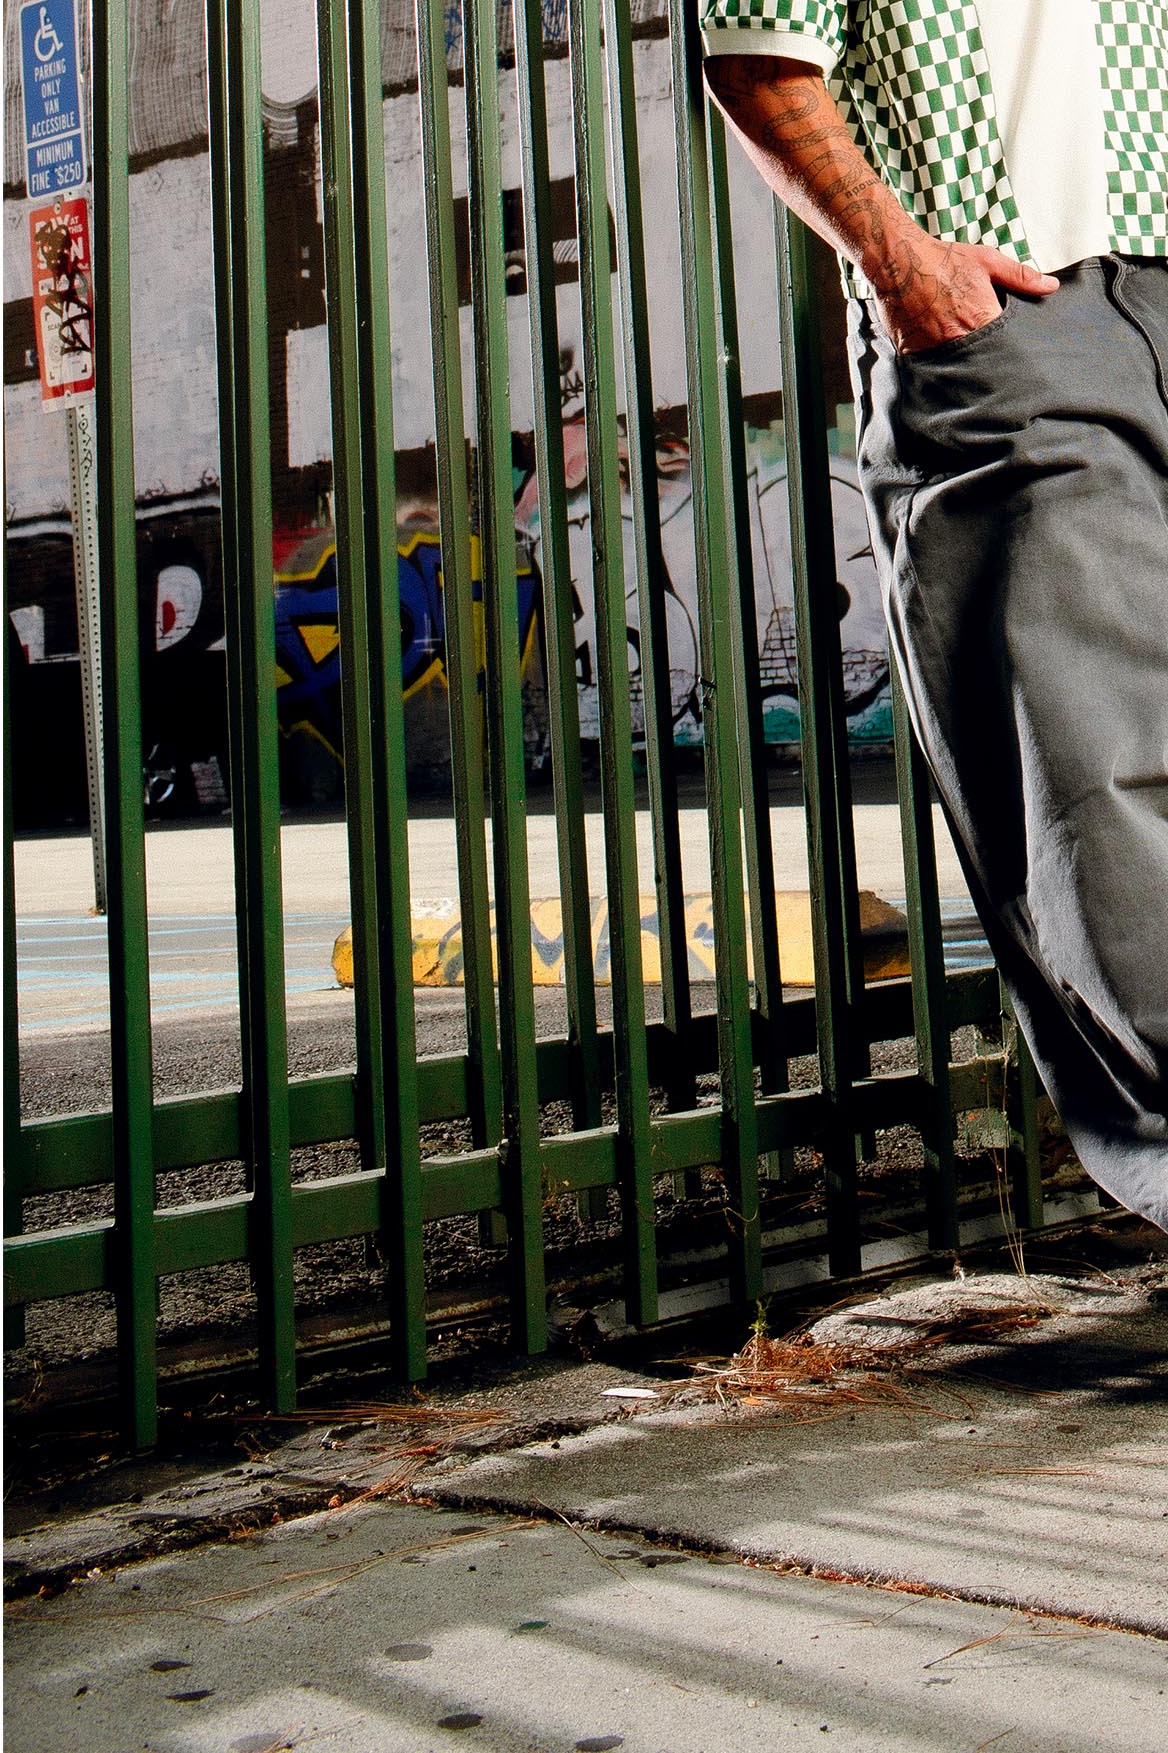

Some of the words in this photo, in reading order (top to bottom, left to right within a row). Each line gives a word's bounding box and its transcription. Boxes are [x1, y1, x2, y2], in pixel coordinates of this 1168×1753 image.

[34, 58, 66, 82] PARKING
[41, 78, 61, 98] ONLY
[44, 98, 60, 116] VAN
[32, 111, 75, 139] ACCESSIBLE
[36, 140, 74, 167] MINIMUM
[31, 170, 51, 193] FINE
